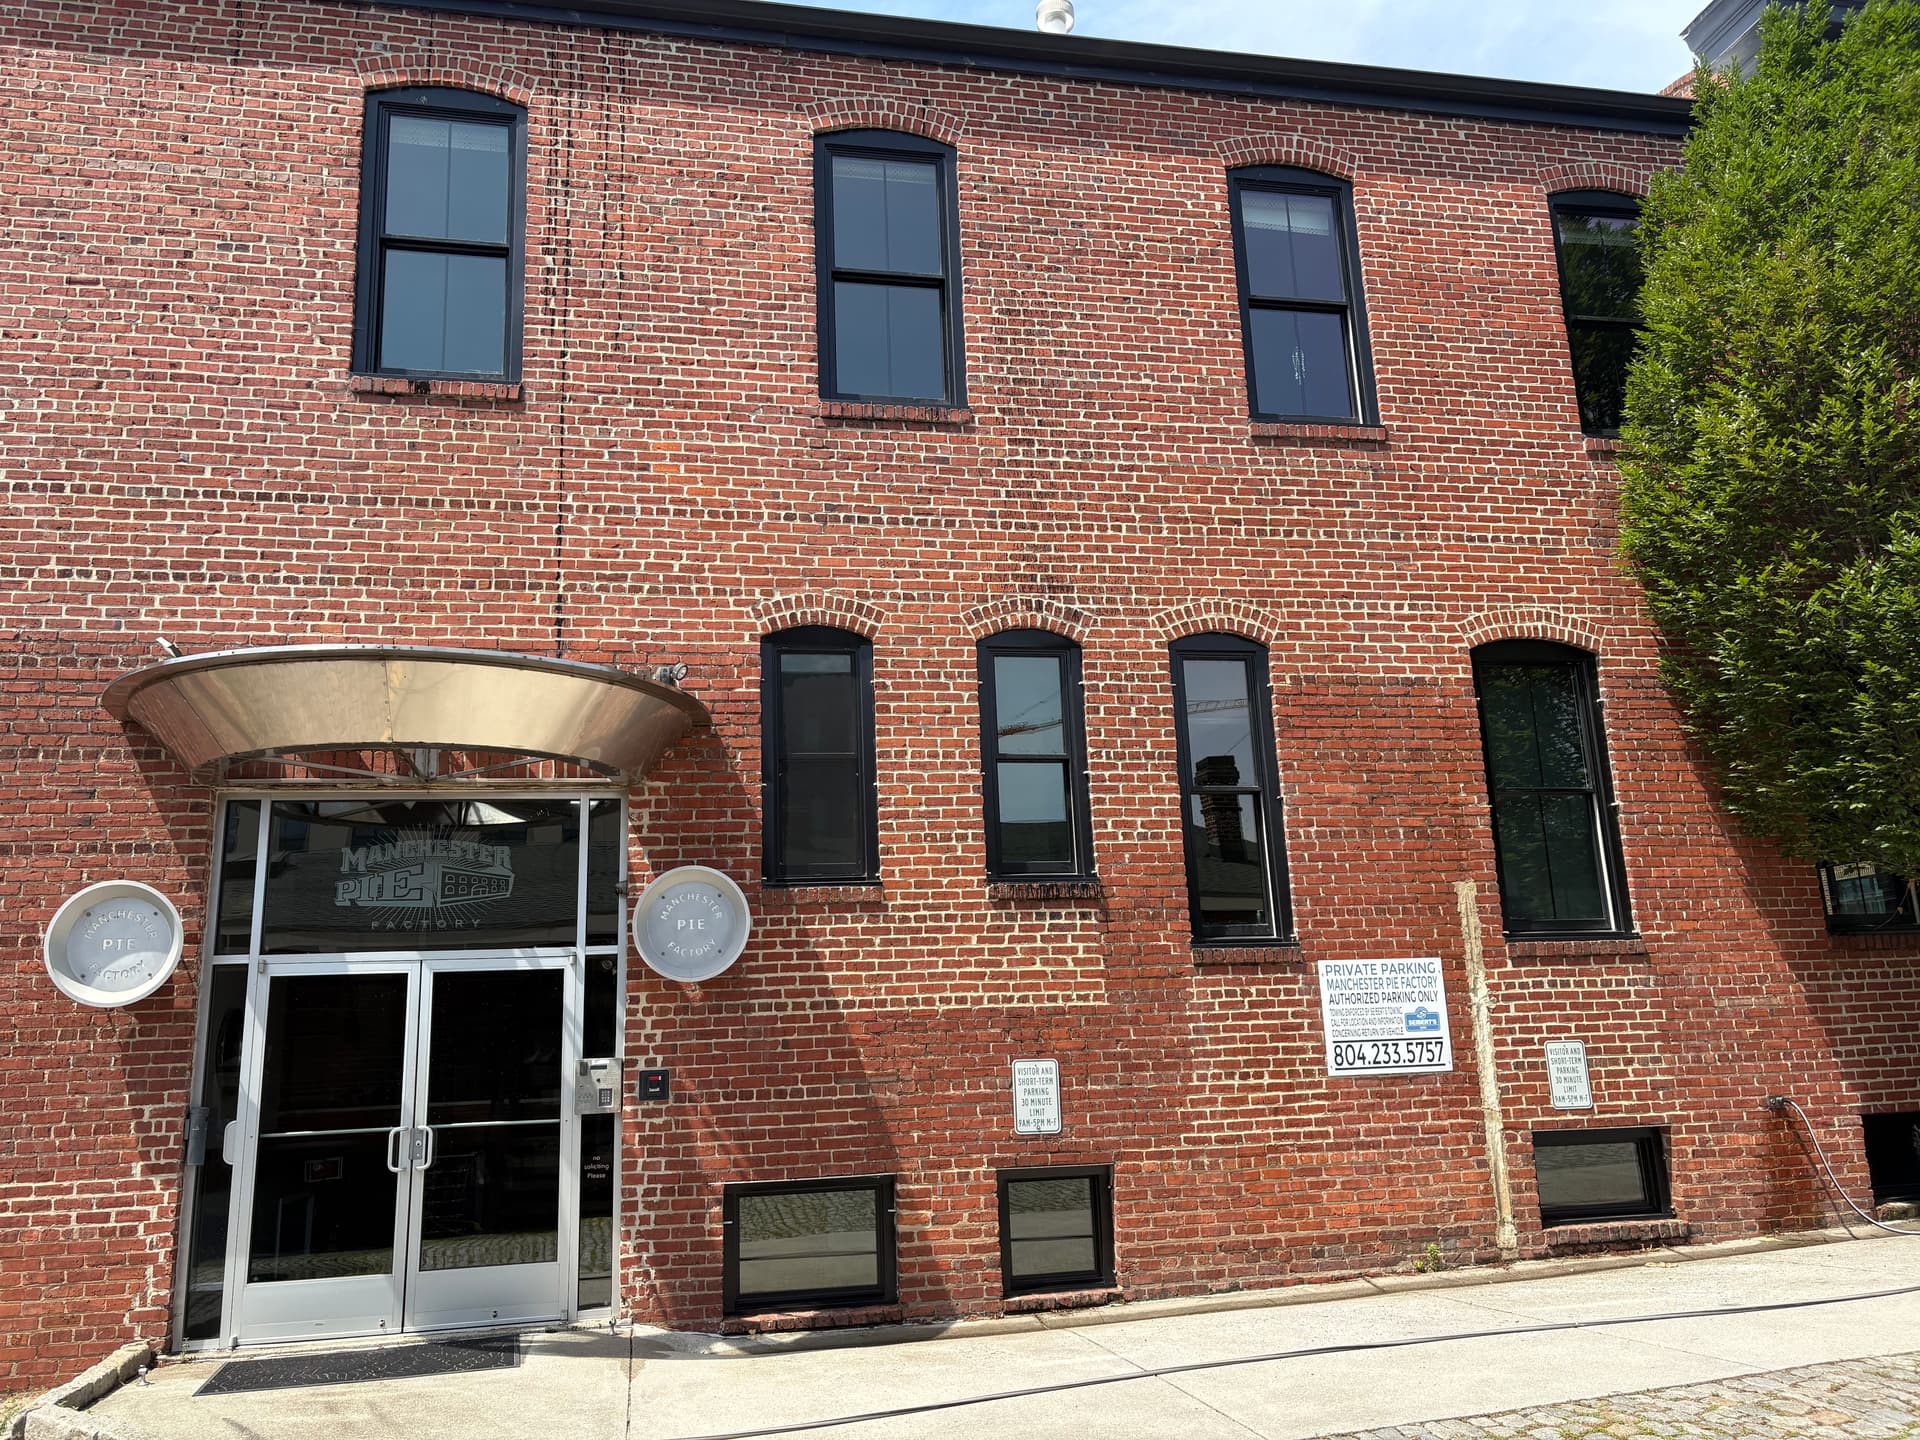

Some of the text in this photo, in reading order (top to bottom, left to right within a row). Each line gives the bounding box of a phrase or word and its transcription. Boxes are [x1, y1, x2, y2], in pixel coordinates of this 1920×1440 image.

[340, 839, 514, 874] MANCHESTER
[335, 861, 433, 908] PIE
[660, 893, 723, 921] MANCHESTER
[84, 909, 158, 939] MANCHESTER
[371, 919, 481, 931] FACTORY
[677, 919, 705, 930] PIE
[102, 938, 137, 951] PIE
[667, 939, 716, 957] FACTORY
[88, 959, 145, 980] FACTORY
[1325, 962, 1436, 976] PRIVATE PARKING
[1326, 976, 1438, 991] MANCHESTER PIE FACTORY
[1329, 990, 1439, 1005] AUTHORIZED PARKING ONLY
[1331, 1018, 1341, 1027] CALL
[1334, 1041, 1444, 1066] 804.233.5757
[1549, 1047, 1581, 1056] VISITOR AND
[1551, 1057, 1582, 1065] SHORT-TERM
[1017, 1067, 1054, 1076] VISITOR AND
[1556, 1066, 1579, 1074] PARKING
[1018, 1078, 1054, 1086] SHORT-TERM
[1555, 1076, 1583, 1084] 30 MINUTE
[1023, 1088, 1049, 1096] PARKING
[1030, 1098, 1052, 1106] MINUTE
[1555, 1095, 1578, 1103] 9AM-5PM
[1029, 1108, 1045, 1117] LIMIT
[1019, 1117, 1057, 1127] 9AM-5PM M-F
